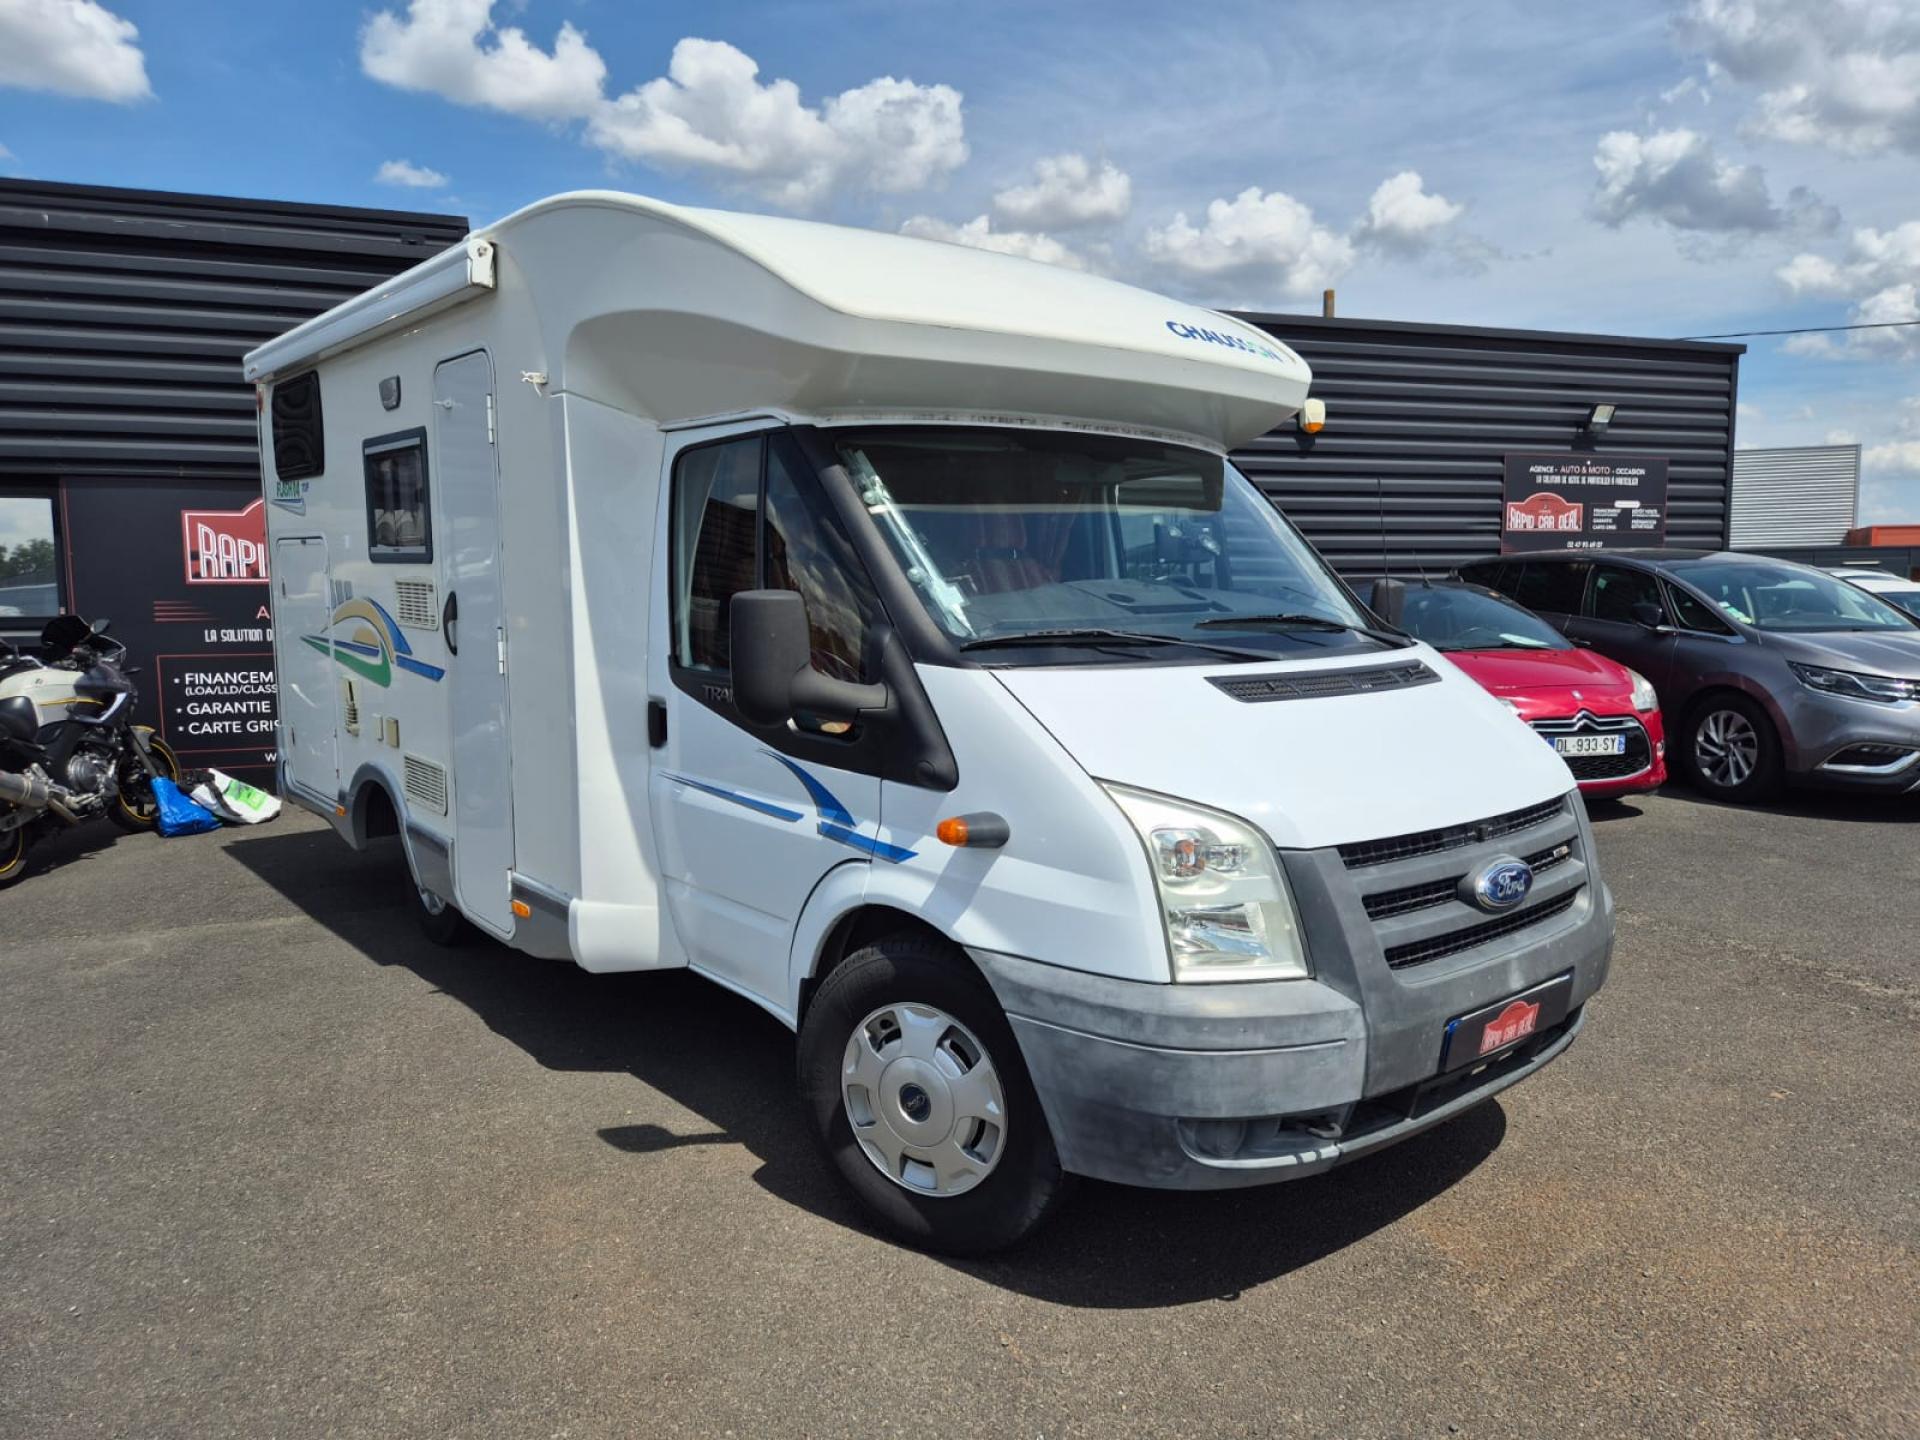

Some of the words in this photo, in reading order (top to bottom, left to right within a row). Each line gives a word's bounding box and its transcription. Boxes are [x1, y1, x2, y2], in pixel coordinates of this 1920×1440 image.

[1529, 465, 1554, 473] AGENCE
[1560, 465, 1580, 474] AUTO
[1588, 466, 1610, 475] MOTO
[1510, 506, 1534, 528] RAPID
[1538, 515, 1554, 528] CAR
[1559, 508, 1578, 528] DEAL
[204, 629, 217, 642] LA
[220, 628, 263, 642] SOLUTION
[186, 701, 271, 715] GARANTIE
[188, 721, 243, 734] CARTE
[1497, 871, 1525, 897] Ford
